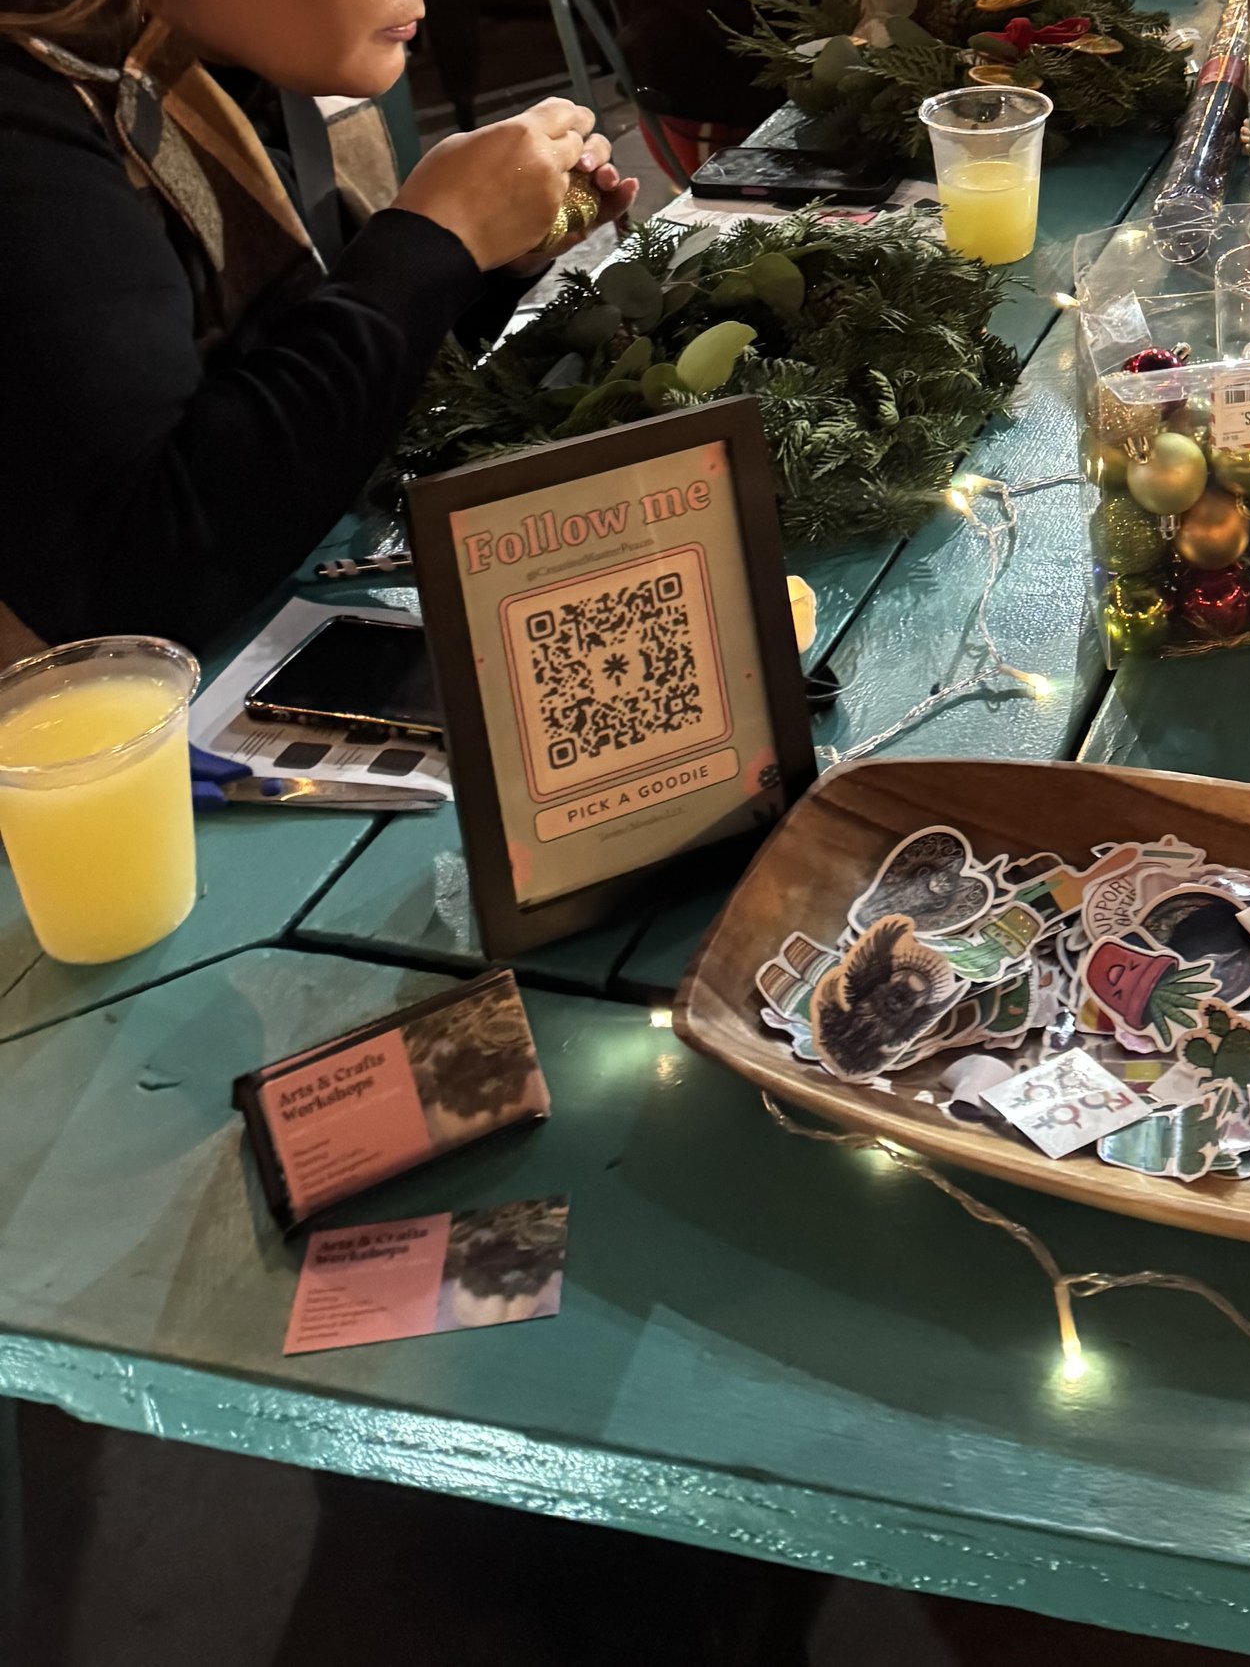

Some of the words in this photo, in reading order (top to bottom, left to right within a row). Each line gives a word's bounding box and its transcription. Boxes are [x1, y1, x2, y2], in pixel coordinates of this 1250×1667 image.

[465, 500, 631, 574] Follow
[641, 479, 711, 526] me
[567, 796, 611, 823] PICK
[617, 790, 632, 806] A
[638, 763, 710, 798] GOODIE
[1093, 874, 1134, 935] UPPORT
[279, 1083, 314, 1108] Arts
[317, 1076, 331, 1090] &
[334, 1054, 387, 1082] Crafts
[281, 1077, 375, 1121] Workshops
